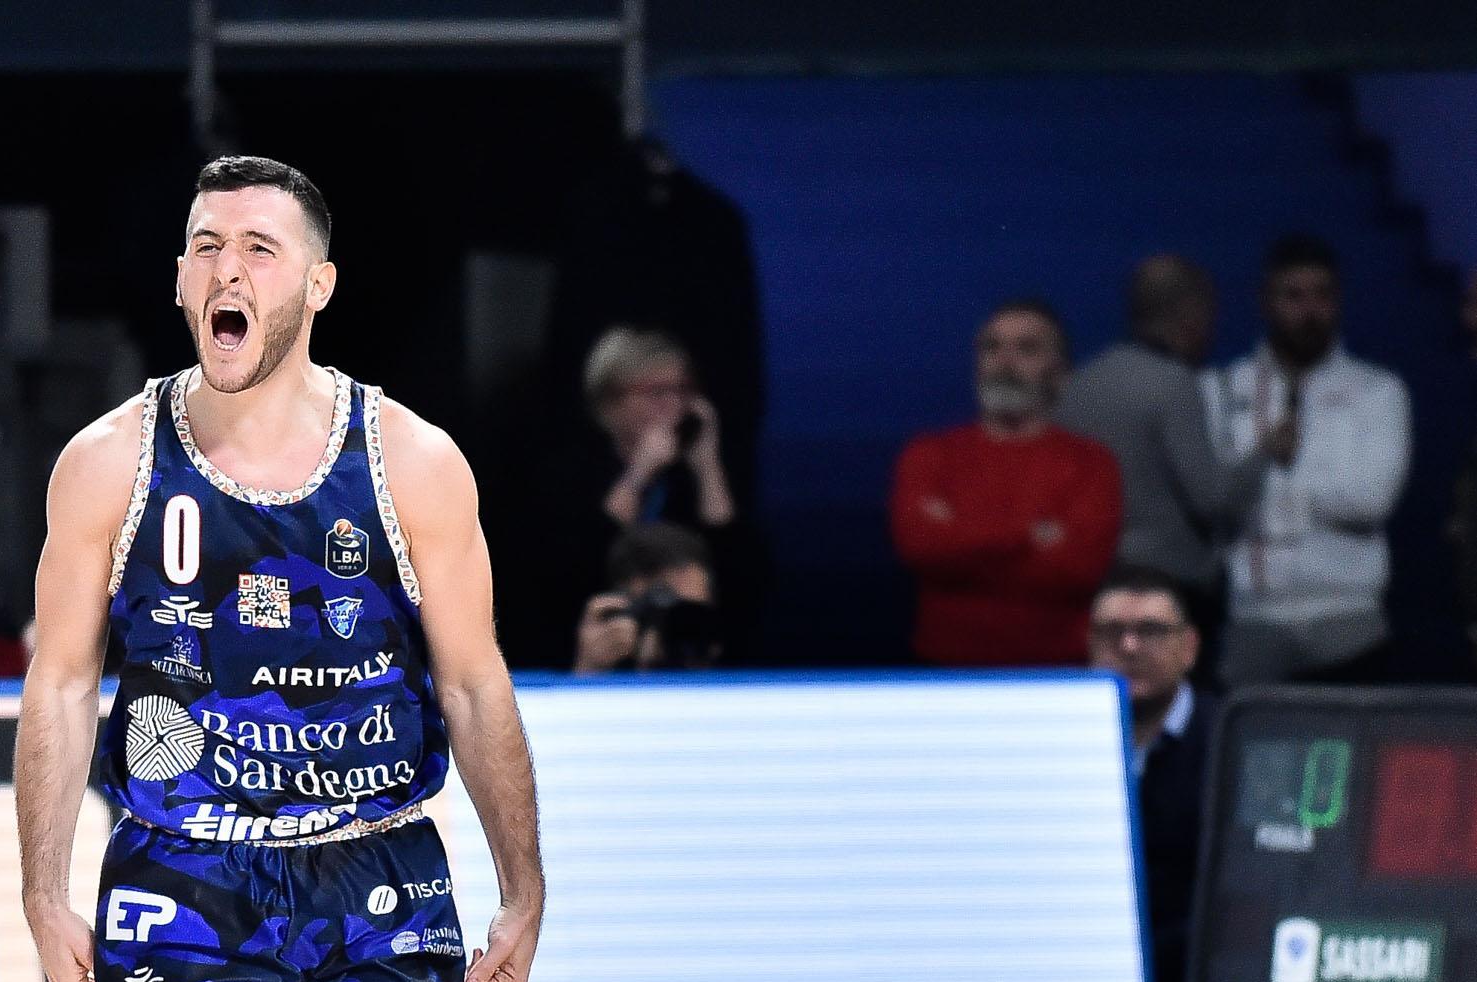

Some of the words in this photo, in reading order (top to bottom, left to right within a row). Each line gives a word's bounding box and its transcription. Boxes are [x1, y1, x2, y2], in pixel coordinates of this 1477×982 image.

[162, 493, 202, 586] 0
[332, 551, 363, 563] LBA
[200, 709, 348, 752] Banco
[358, 703, 396, 746] di
[106, 888, 178, 942] EP
